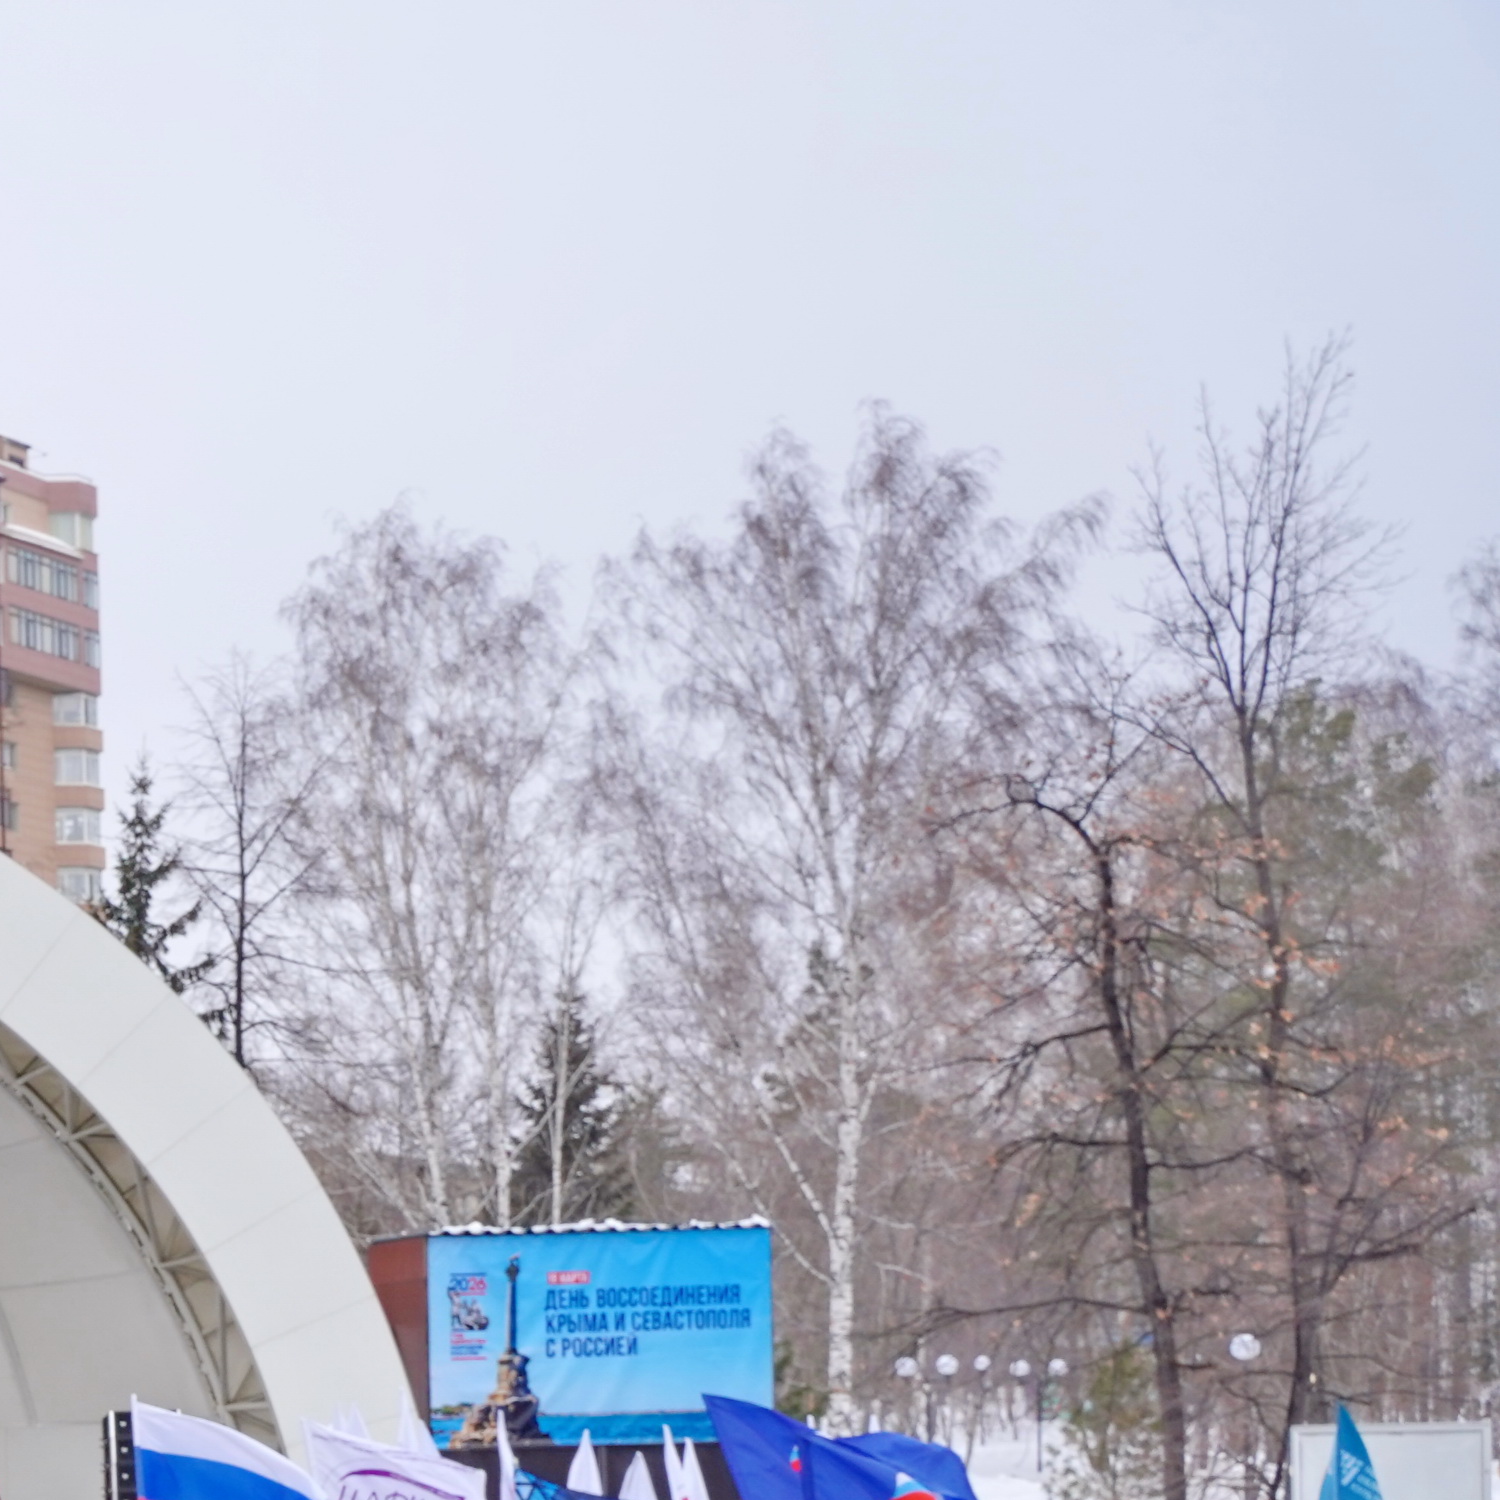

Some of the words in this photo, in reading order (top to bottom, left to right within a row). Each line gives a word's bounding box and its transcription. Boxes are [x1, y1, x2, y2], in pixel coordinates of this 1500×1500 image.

[450, 1277, 487, 1291] 2026
[544, 1287, 590, 1310] ДЕНЬ
[596, 1284, 741, 1308] ВОССОЕДИНЕНИЯ
[545, 1312, 609, 1334] КРЫМА
[614, 1311, 625, 1331] И
[631, 1308, 752, 1331] СЕВАСТОПОЛЯ
[545, 1339, 556, 1358] С
[561, 1332, 639, 1357] РОССИЕЙ
